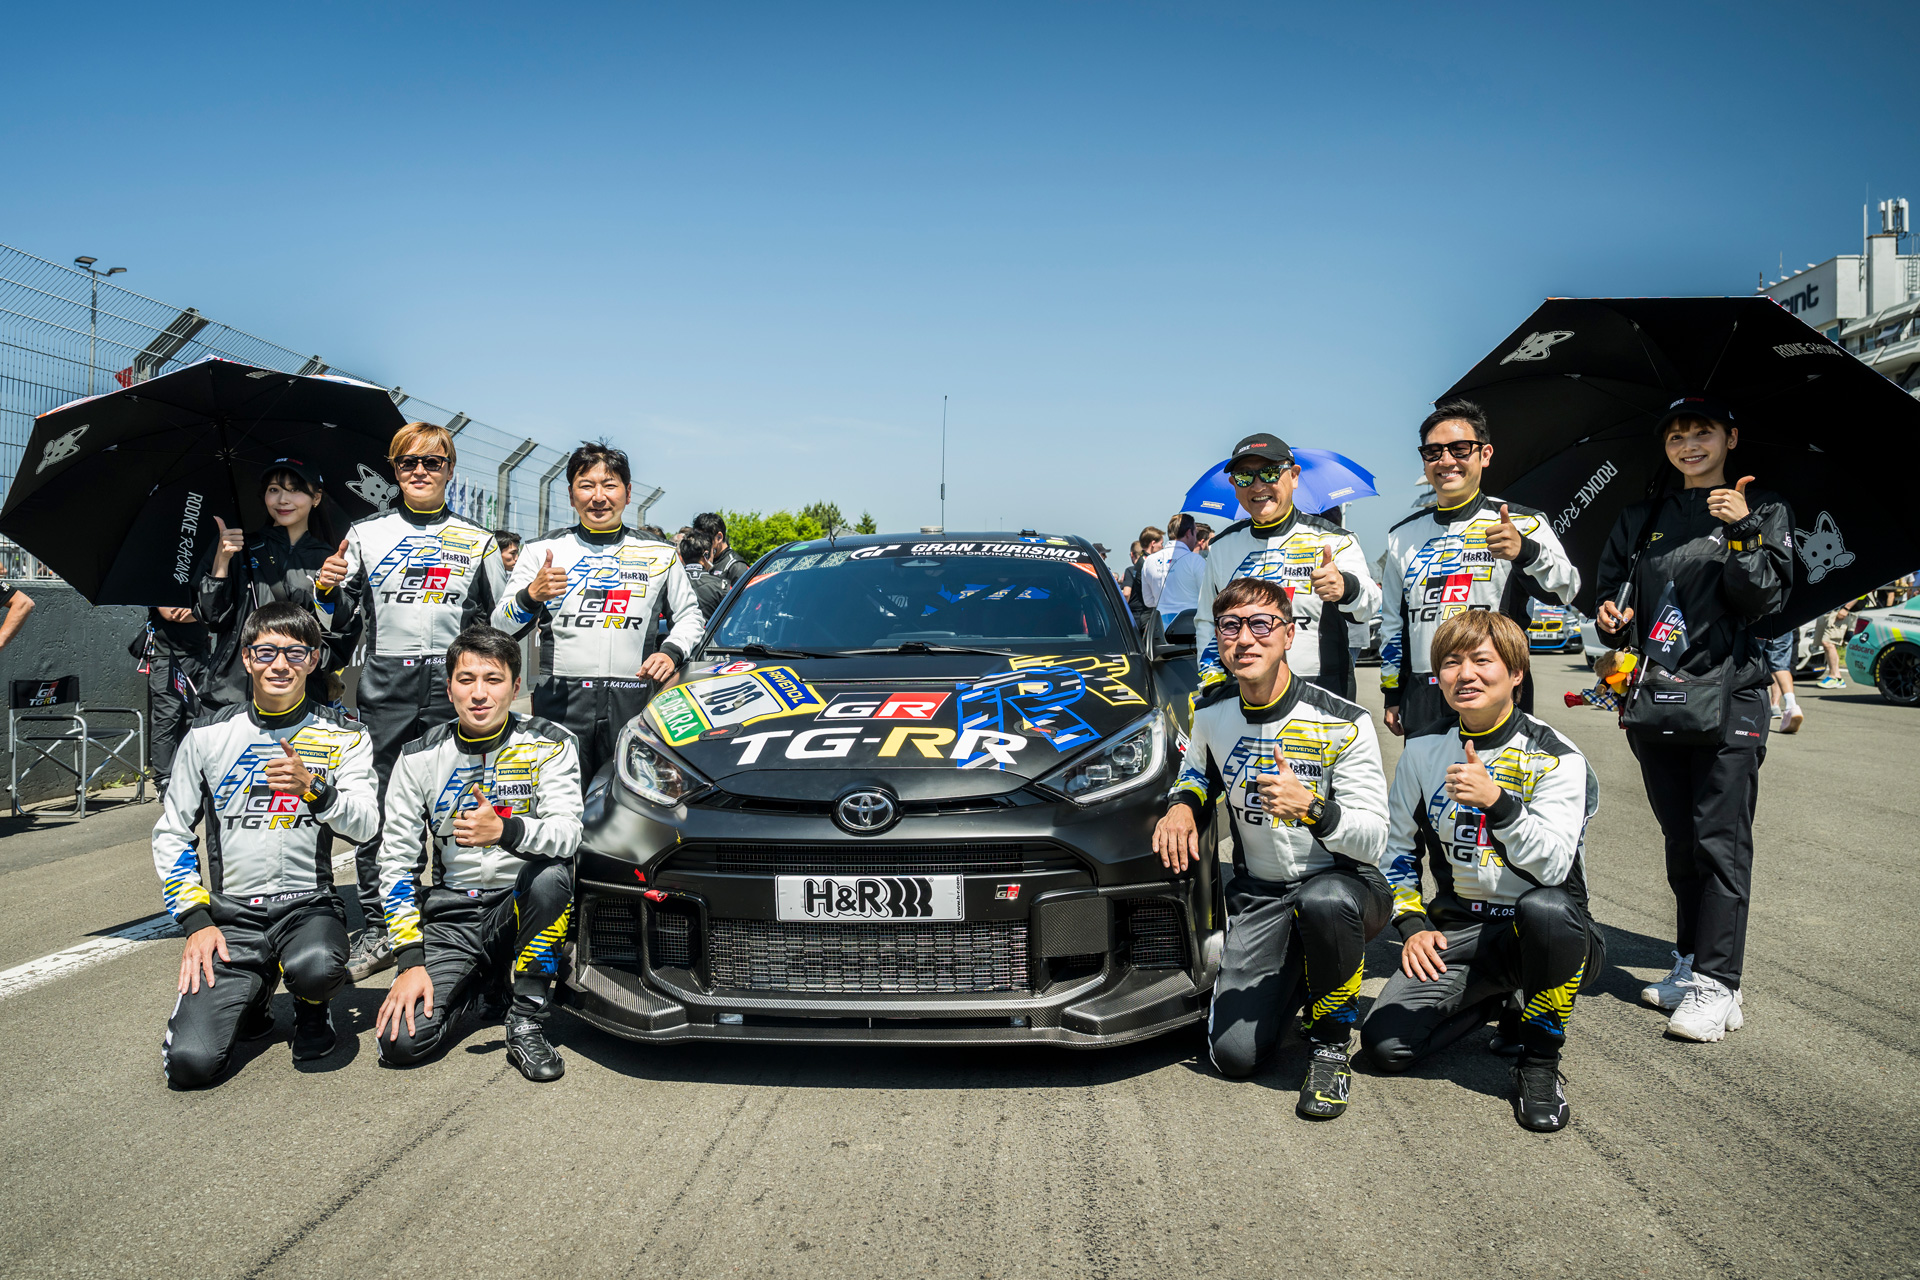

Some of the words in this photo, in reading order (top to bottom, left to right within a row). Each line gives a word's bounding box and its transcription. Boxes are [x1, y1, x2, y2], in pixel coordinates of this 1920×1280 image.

[1574, 460, 1619, 509] ROOKIE
[180, 491, 204, 537] ROOKIE
[910, 543, 977, 552] GRAN
[980, 543, 1081, 559] TURISMO
[1014, 552, 1078, 563] SIMULATOR
[1462, 551, 1482, 562] H&R
[173, 535, 194, 585] RACING
[1284, 566, 1304, 577] H&R
[401, 575, 447, 590] GR
[380, 591, 461, 605] TG-RR
[1424, 585, 1469, 604] GR
[580, 598, 628, 613] GR
[558, 614, 644, 631] TG-RR
[603, 680, 641, 689] T.KATAOKA
[766, 670, 807, 704] RAVENOL
[29, 696, 58, 706] TG-RR
[698, 681, 765, 716] 109
[823, 701, 937, 718] GR
[658, 697, 699, 739] DEKRA
[296, 749, 326, 758] RAVENOL
[729, 726, 1028, 766] TG-RR
[1287, 745, 1318, 754] RAVENOL
[247, 795, 300, 813] GR
[804, 878, 889, 917] H&R
[996, 890, 1018, 898] GR
